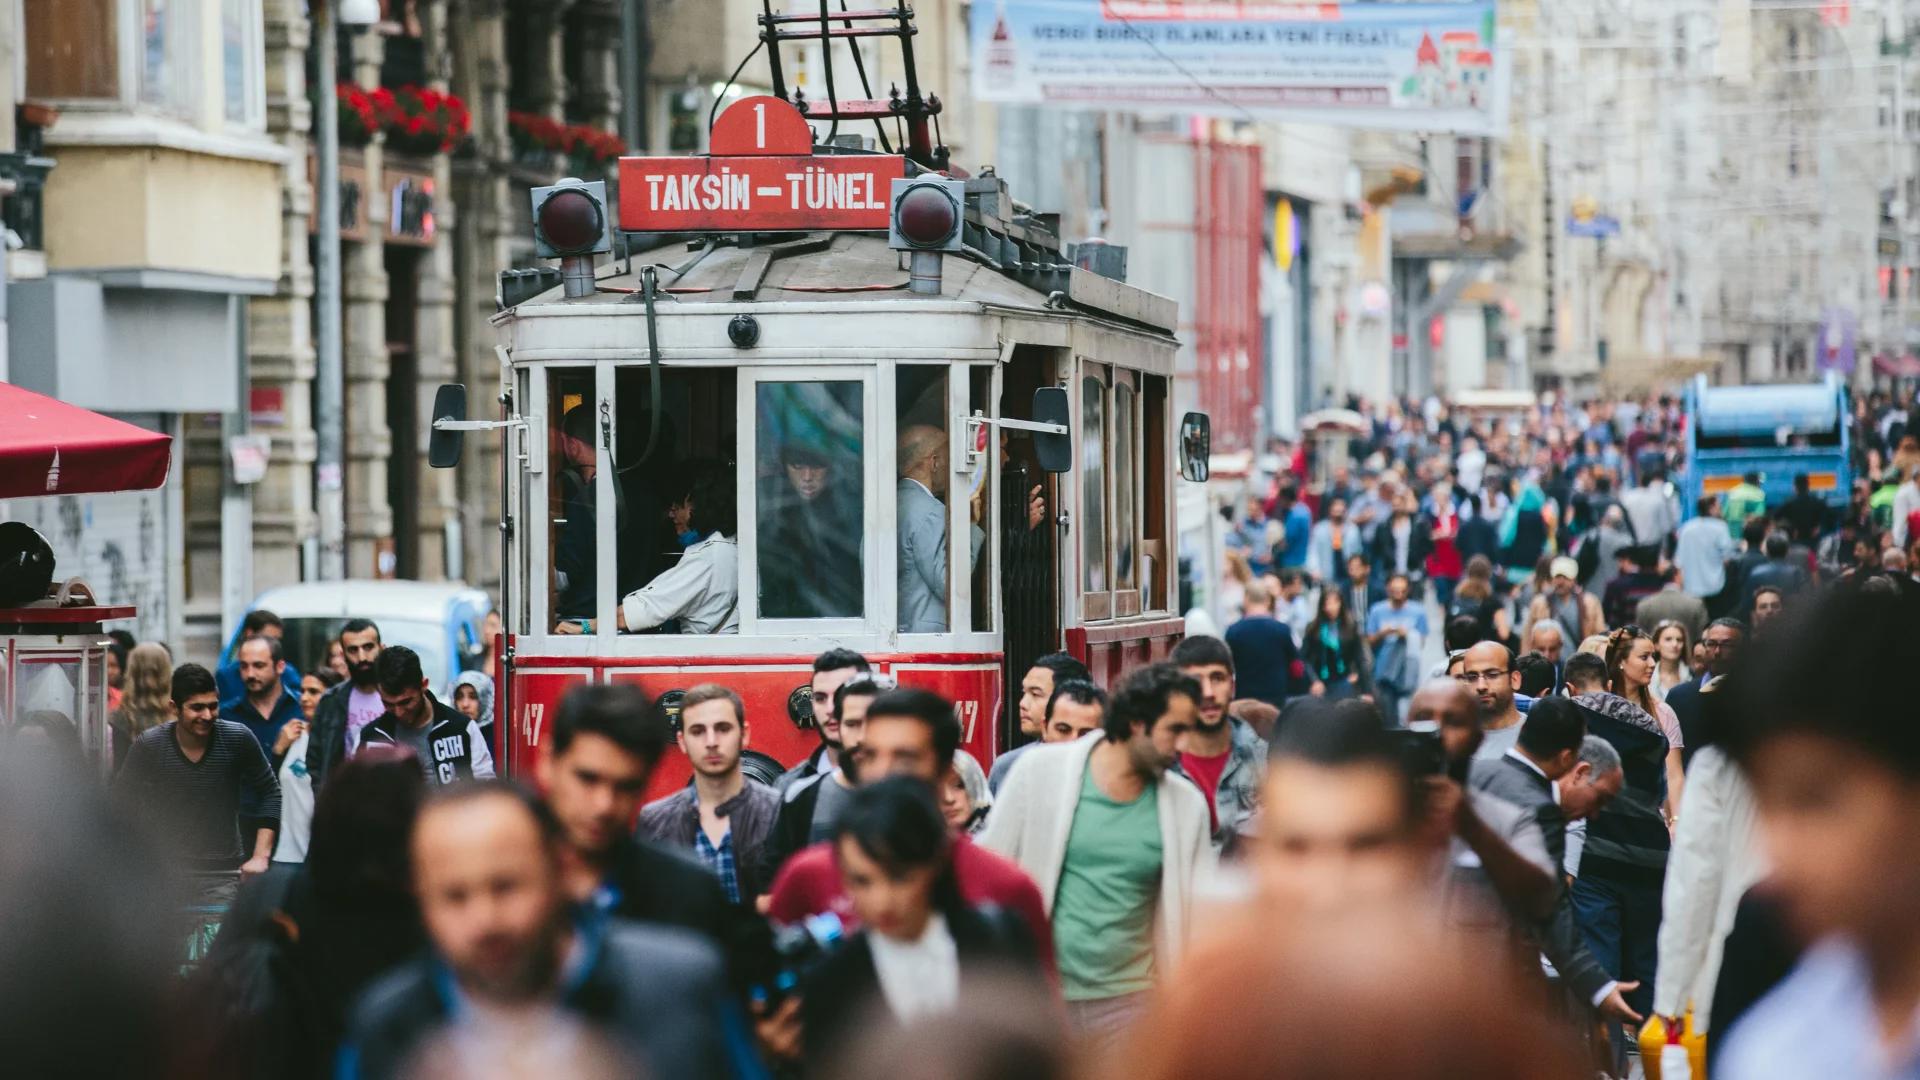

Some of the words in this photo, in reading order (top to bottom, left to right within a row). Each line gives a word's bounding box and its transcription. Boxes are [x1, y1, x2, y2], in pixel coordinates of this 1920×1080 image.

[753, 103, 765, 149] 1
[645, 166, 750, 211] TAKSİM
[785, 166, 885, 210] TÜNEL
[522, 703, 545, 747] 47
[952, 700, 979, 744] 47
